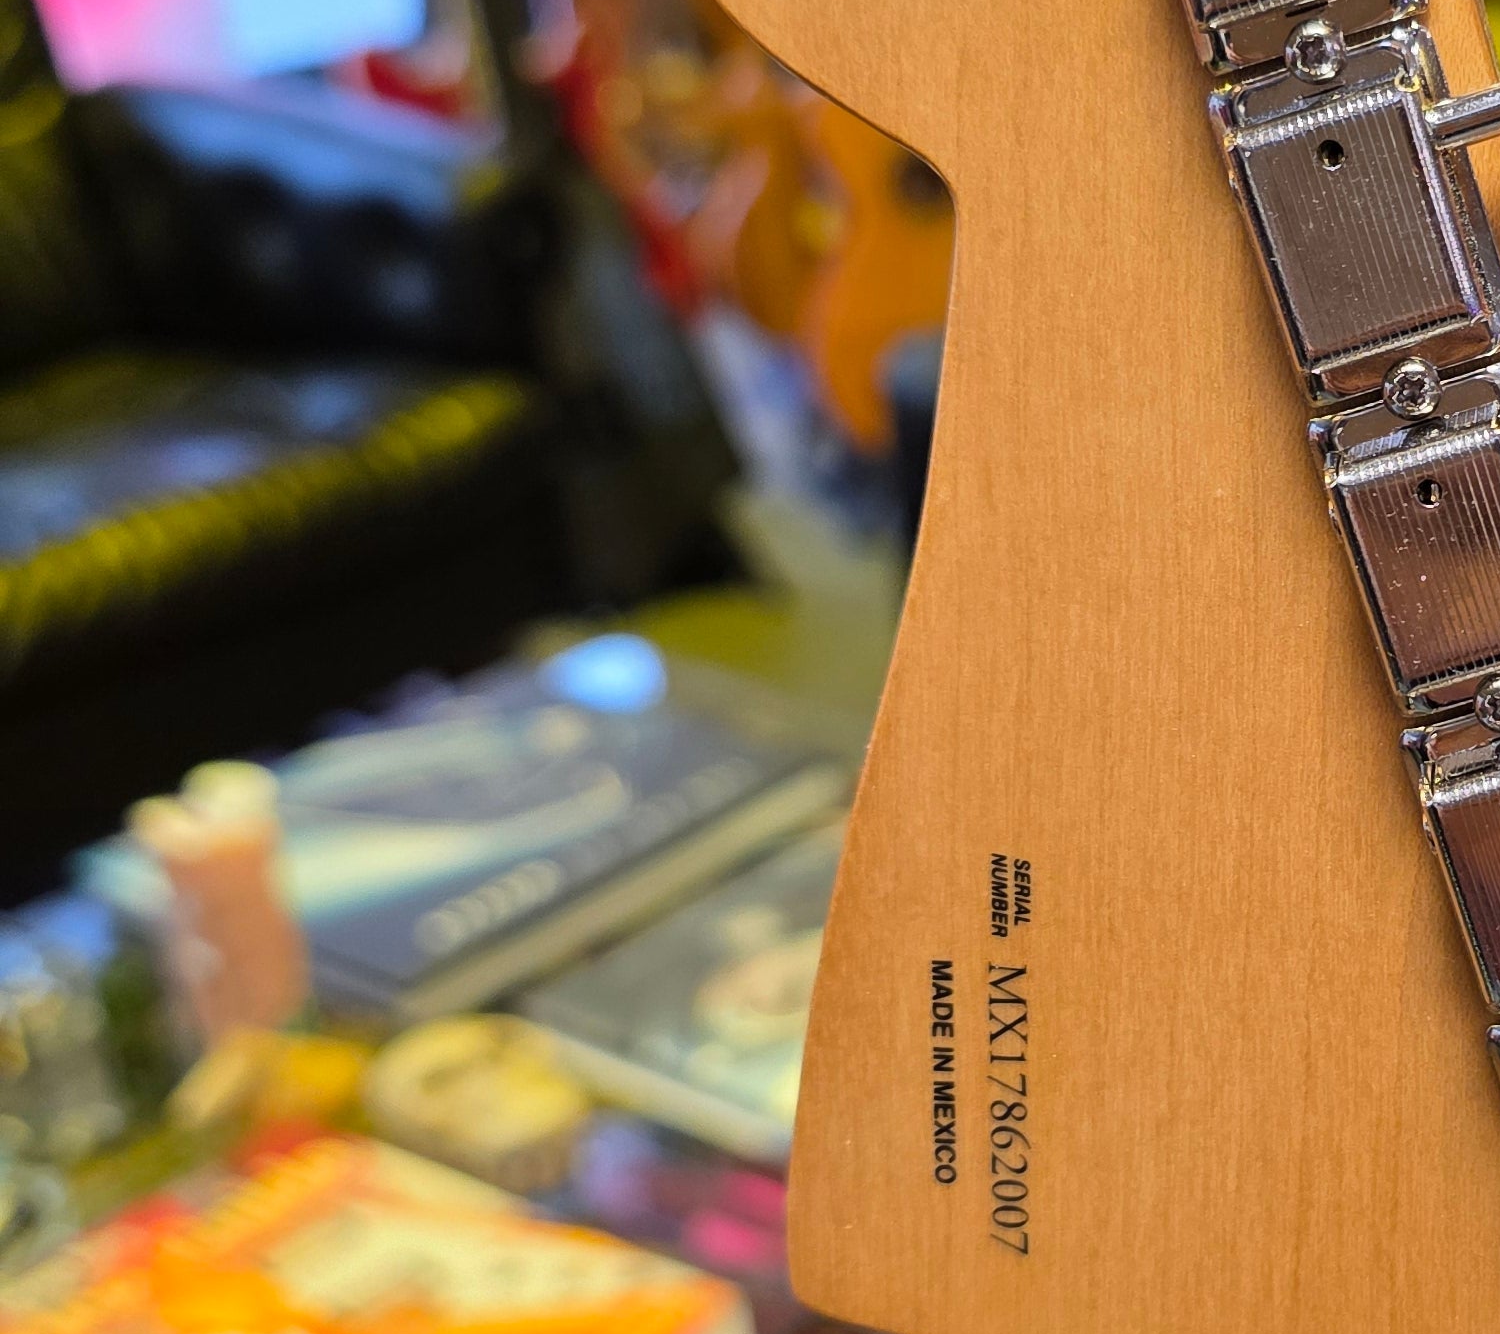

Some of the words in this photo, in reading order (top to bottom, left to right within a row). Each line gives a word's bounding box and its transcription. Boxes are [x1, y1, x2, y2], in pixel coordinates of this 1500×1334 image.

[990, 852, 1009, 938] NUMBER
[1013, 858, 1031, 927] SERIAL
[930, 959, 955, 1038] MADE
[932, 1046, 955, 1072] IN
[933, 1080, 958, 1185] MEXICO
[986, 961, 1031, 1256] MX17862007
